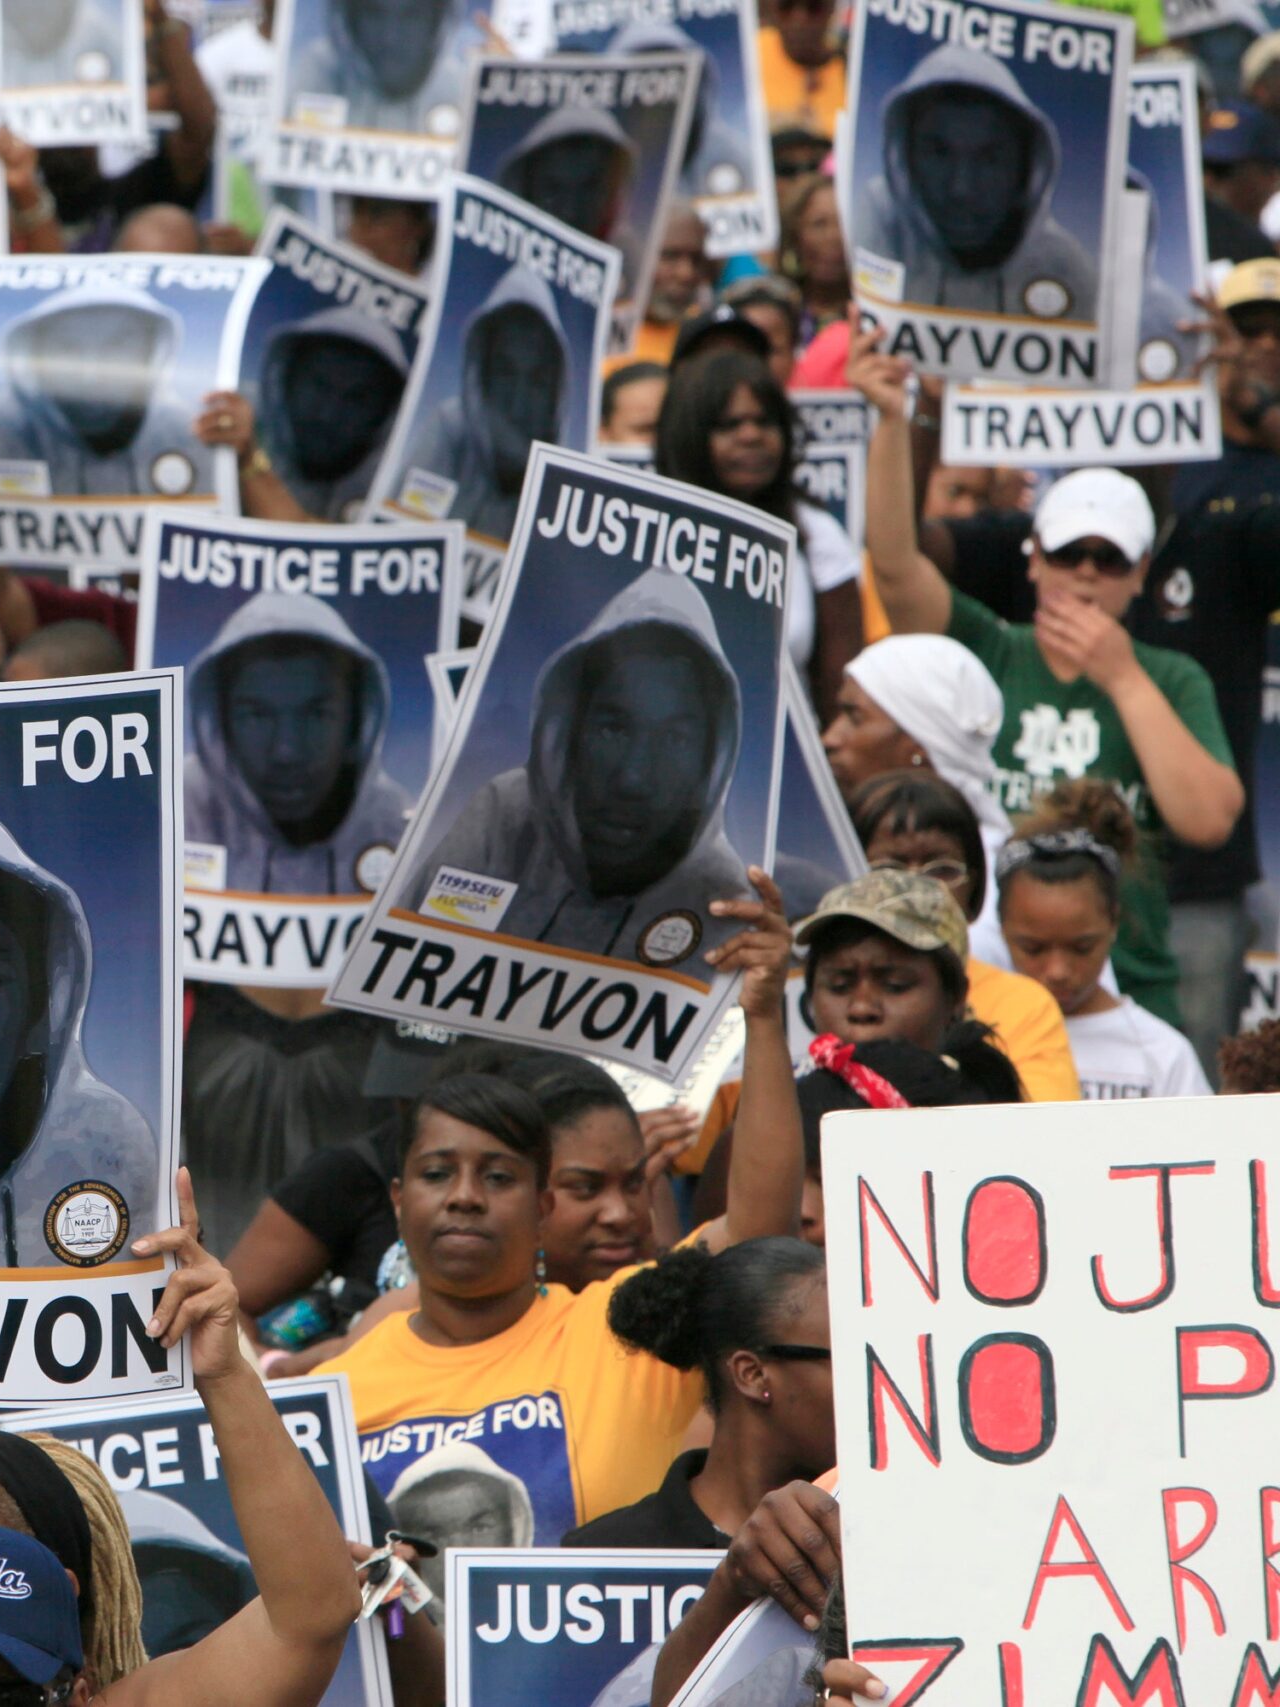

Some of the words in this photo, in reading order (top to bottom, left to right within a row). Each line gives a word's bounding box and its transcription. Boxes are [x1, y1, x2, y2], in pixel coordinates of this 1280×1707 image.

[1024, 21, 1112, 75] FOR
[481, 68, 616, 108] JUSTICE
[622, 67, 683, 106] FOR
[156, 265, 240, 291] FOR
[273, 234, 419, 331] JUSTICE
[455, 199, 558, 279] JUSTICE
[557, 249, 605, 309] FOR
[956, 400, 1203, 449] TRAYVON
[158, 533, 341, 595] JUSTICE
[350, 547, 440, 596] FOR
[537, 484, 720, 585] JUSTICE
[724, 533, 784, 610] FOR
[22, 712, 153, 787] FOR
[360, 928, 699, 1064] TRAYVON
[74, 1218, 101, 1227] NAACP
[858, 1169, 1048, 1308] NO
[361, 1412, 486, 1464] JUSTICE
[492, 1394, 562, 1436] FOR
[866, 1332, 1057, 1472] NO
